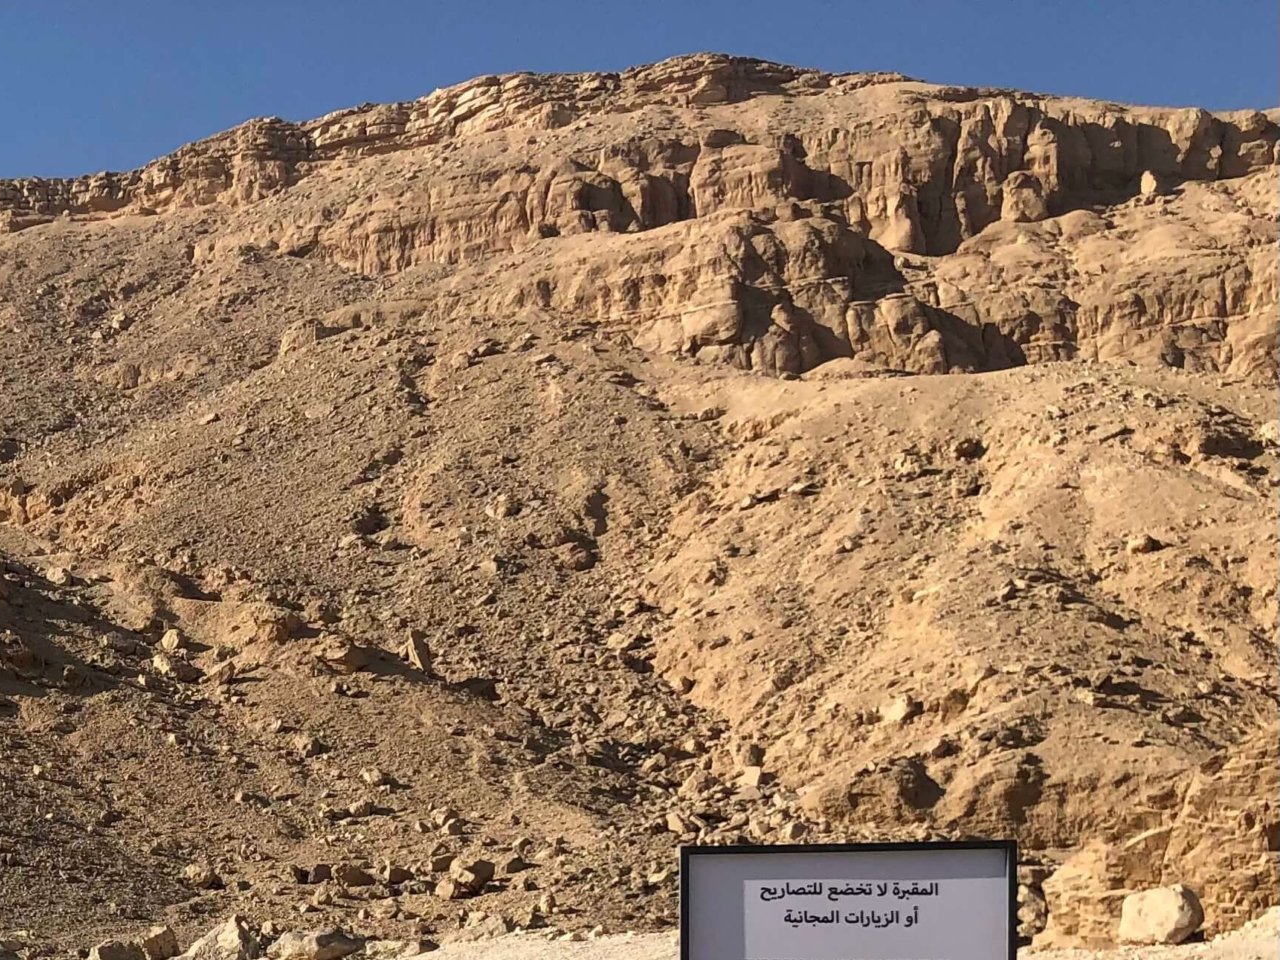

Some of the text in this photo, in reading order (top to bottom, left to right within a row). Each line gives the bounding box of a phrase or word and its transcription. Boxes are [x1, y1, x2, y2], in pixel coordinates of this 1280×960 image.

[759, 882, 939, 901] المقبرة لا تخضع للتصاريح
[783, 906, 919, 928] أو الزيارات المجانية
